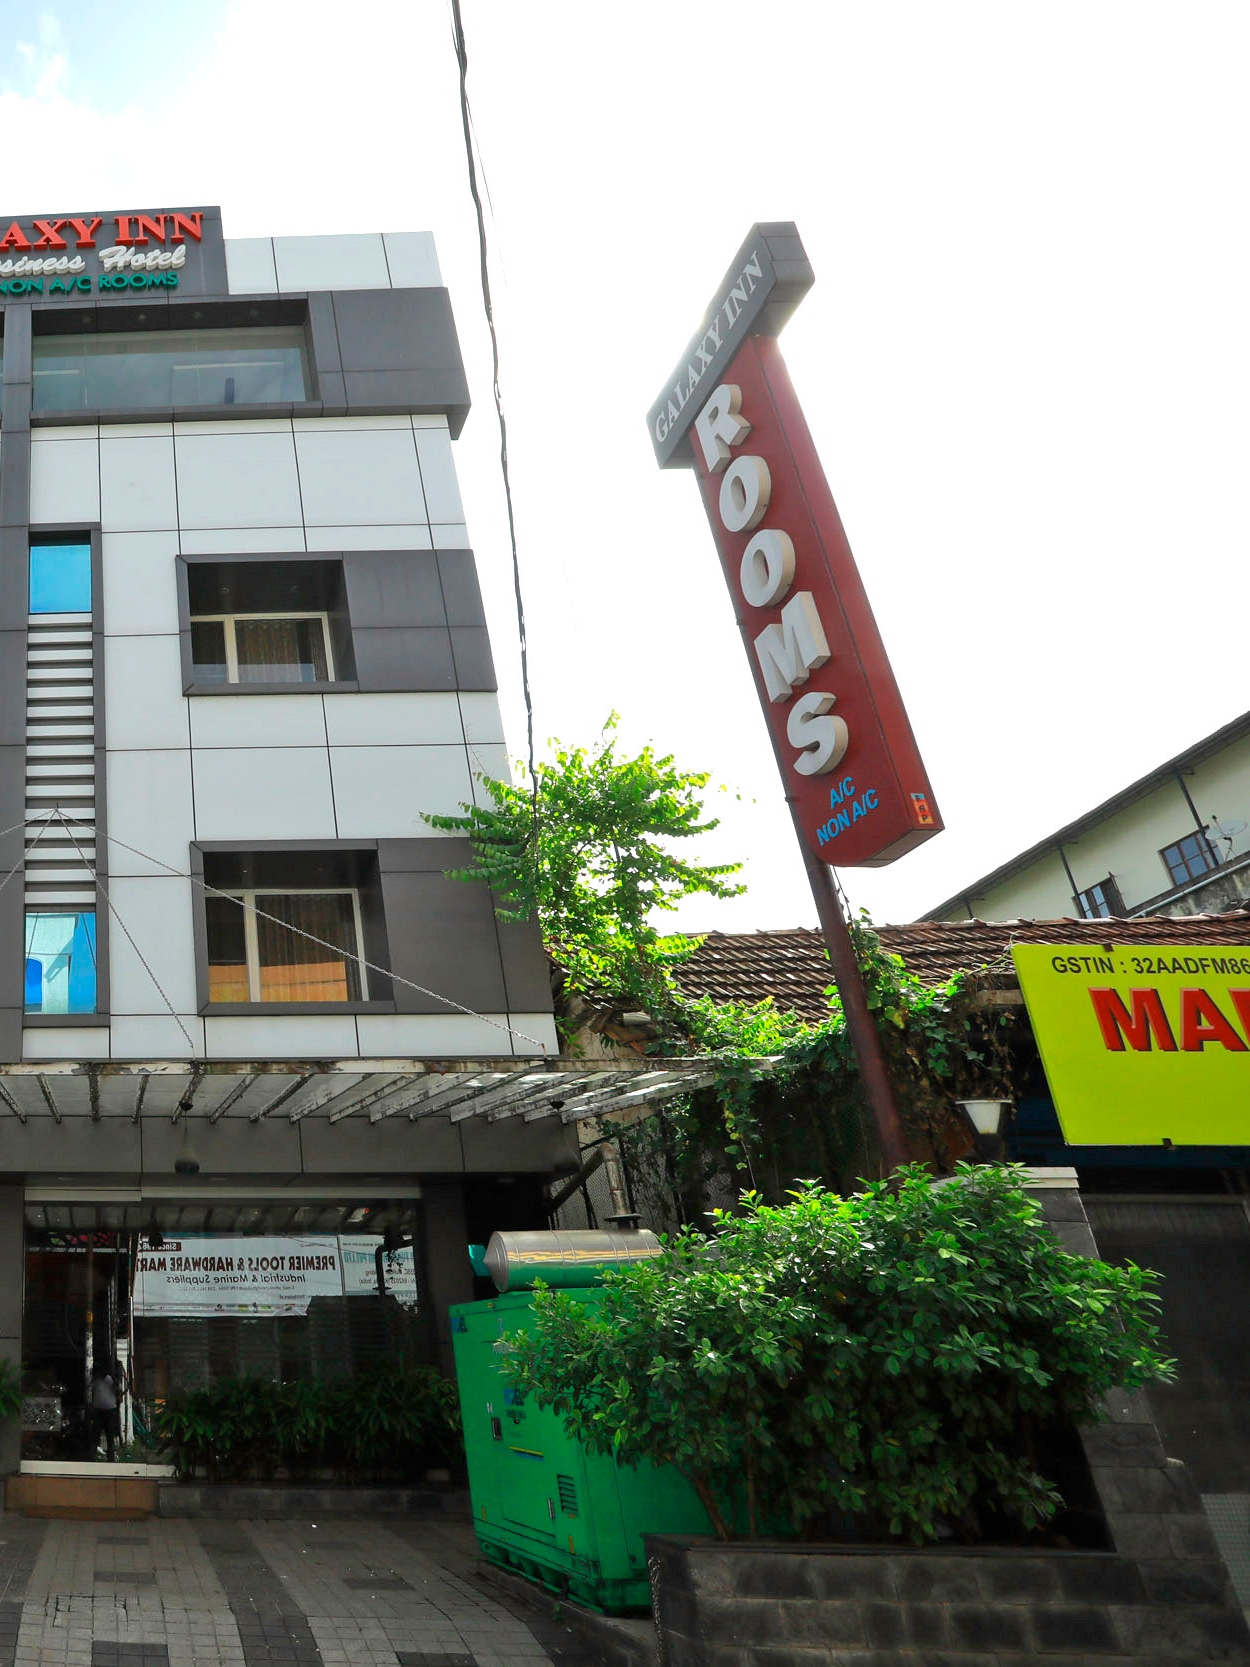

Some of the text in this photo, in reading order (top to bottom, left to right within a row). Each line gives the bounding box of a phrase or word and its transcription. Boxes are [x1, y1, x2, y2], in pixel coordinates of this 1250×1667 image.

[114, 212, 204, 245] INN
[99, 245, 186, 272] Hotel
[49, 275, 92, 296] A/C
[99, 271, 179, 293] ROOMS
[655, 250, 764, 443] GALAXY INN
[695, 384, 849, 777] ROOMS
[830, 776, 855, 809] A/C
[816, 788, 879, 846] NON A/C
[1051, 955, 1115, 975] GSTIN
[1088, 986, 1250, 1052] MA
